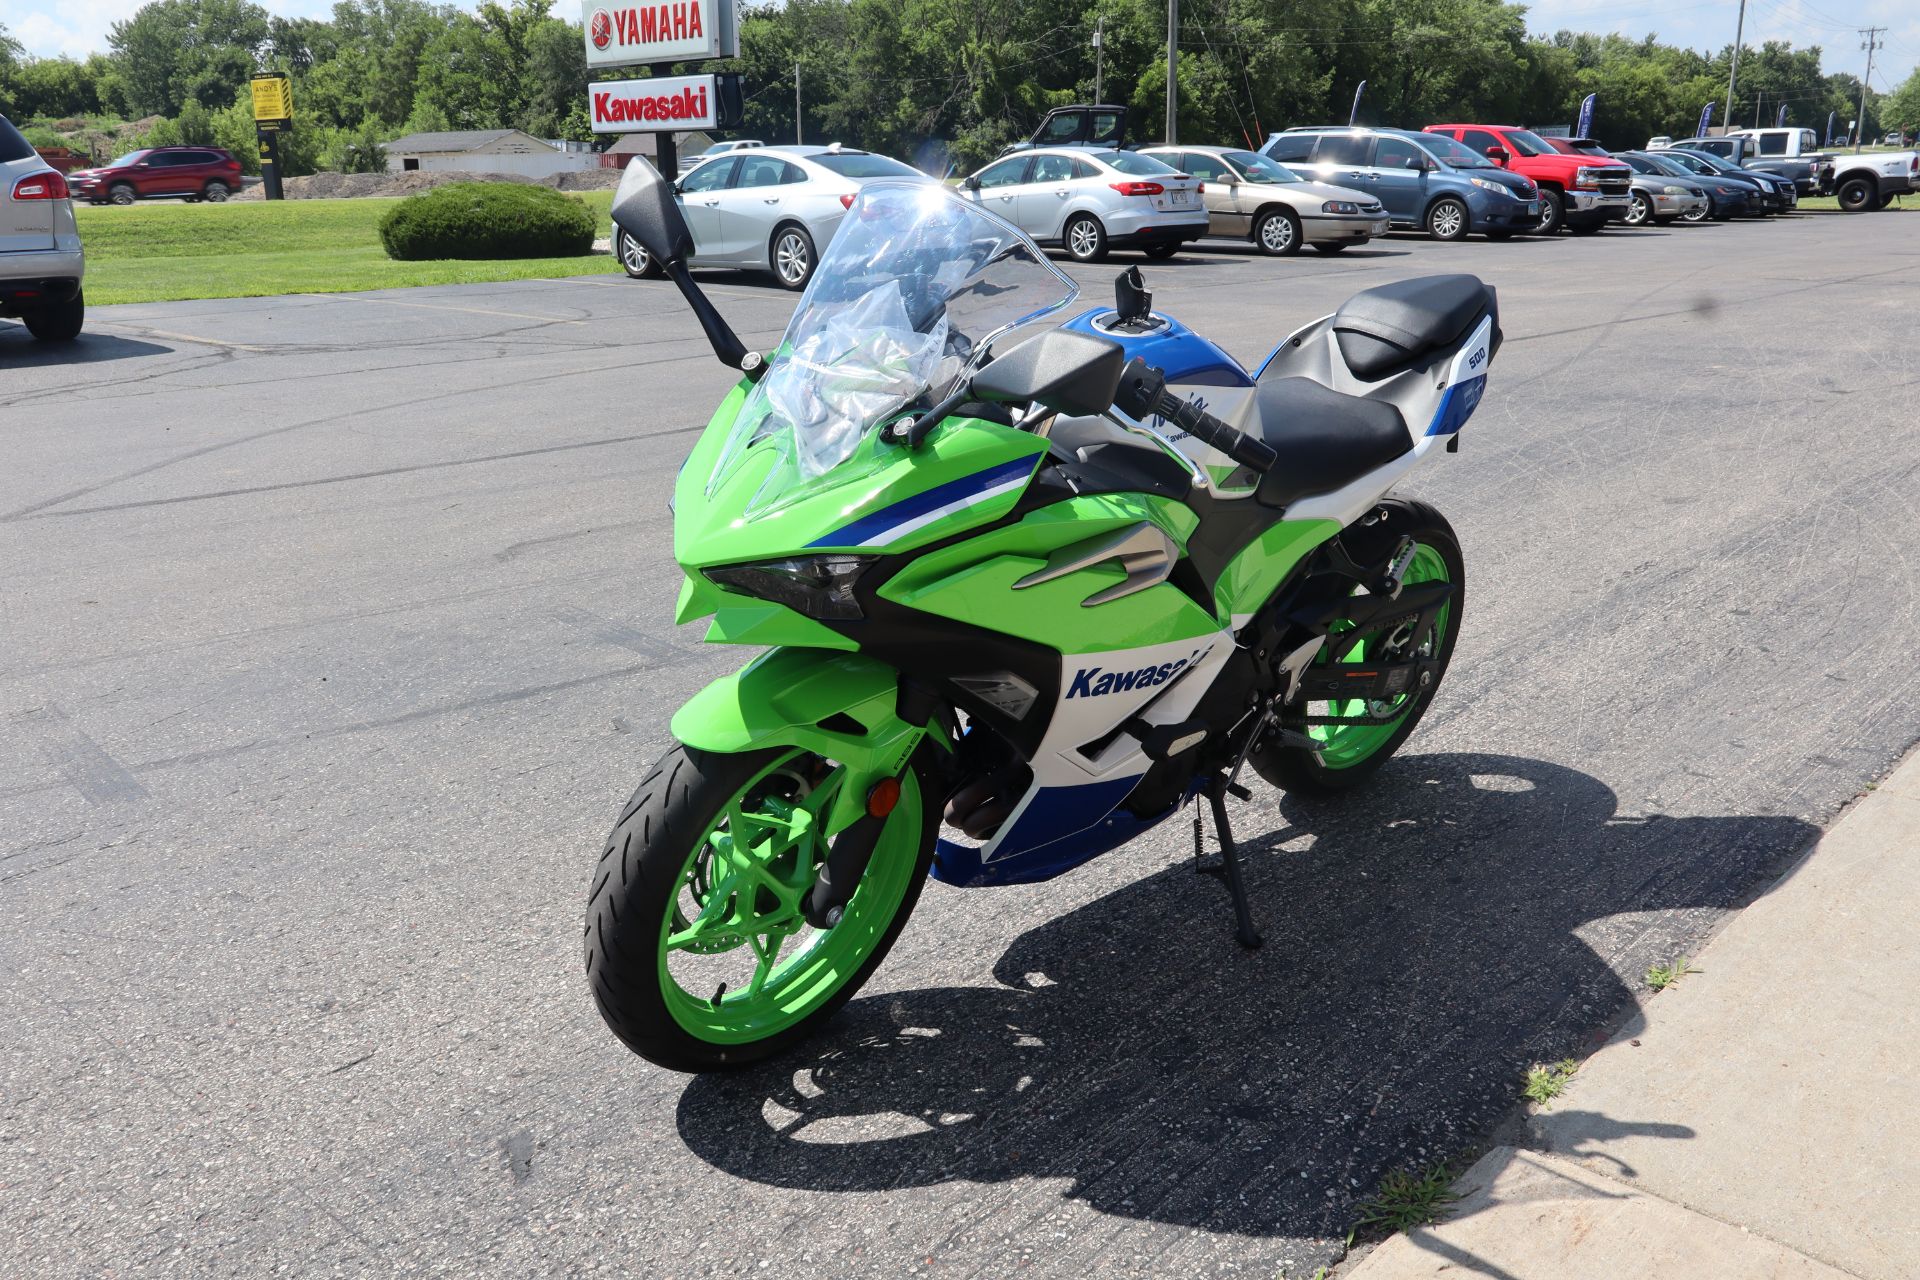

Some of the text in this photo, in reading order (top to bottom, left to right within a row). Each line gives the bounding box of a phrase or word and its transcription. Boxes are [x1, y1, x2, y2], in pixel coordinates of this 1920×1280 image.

[614, 1, 703, 46] YAMAHA
[594, 85, 707, 123] Kawasaki
[1468, 347, 1486, 370] 500
[894, 732, 920, 770] ABS
